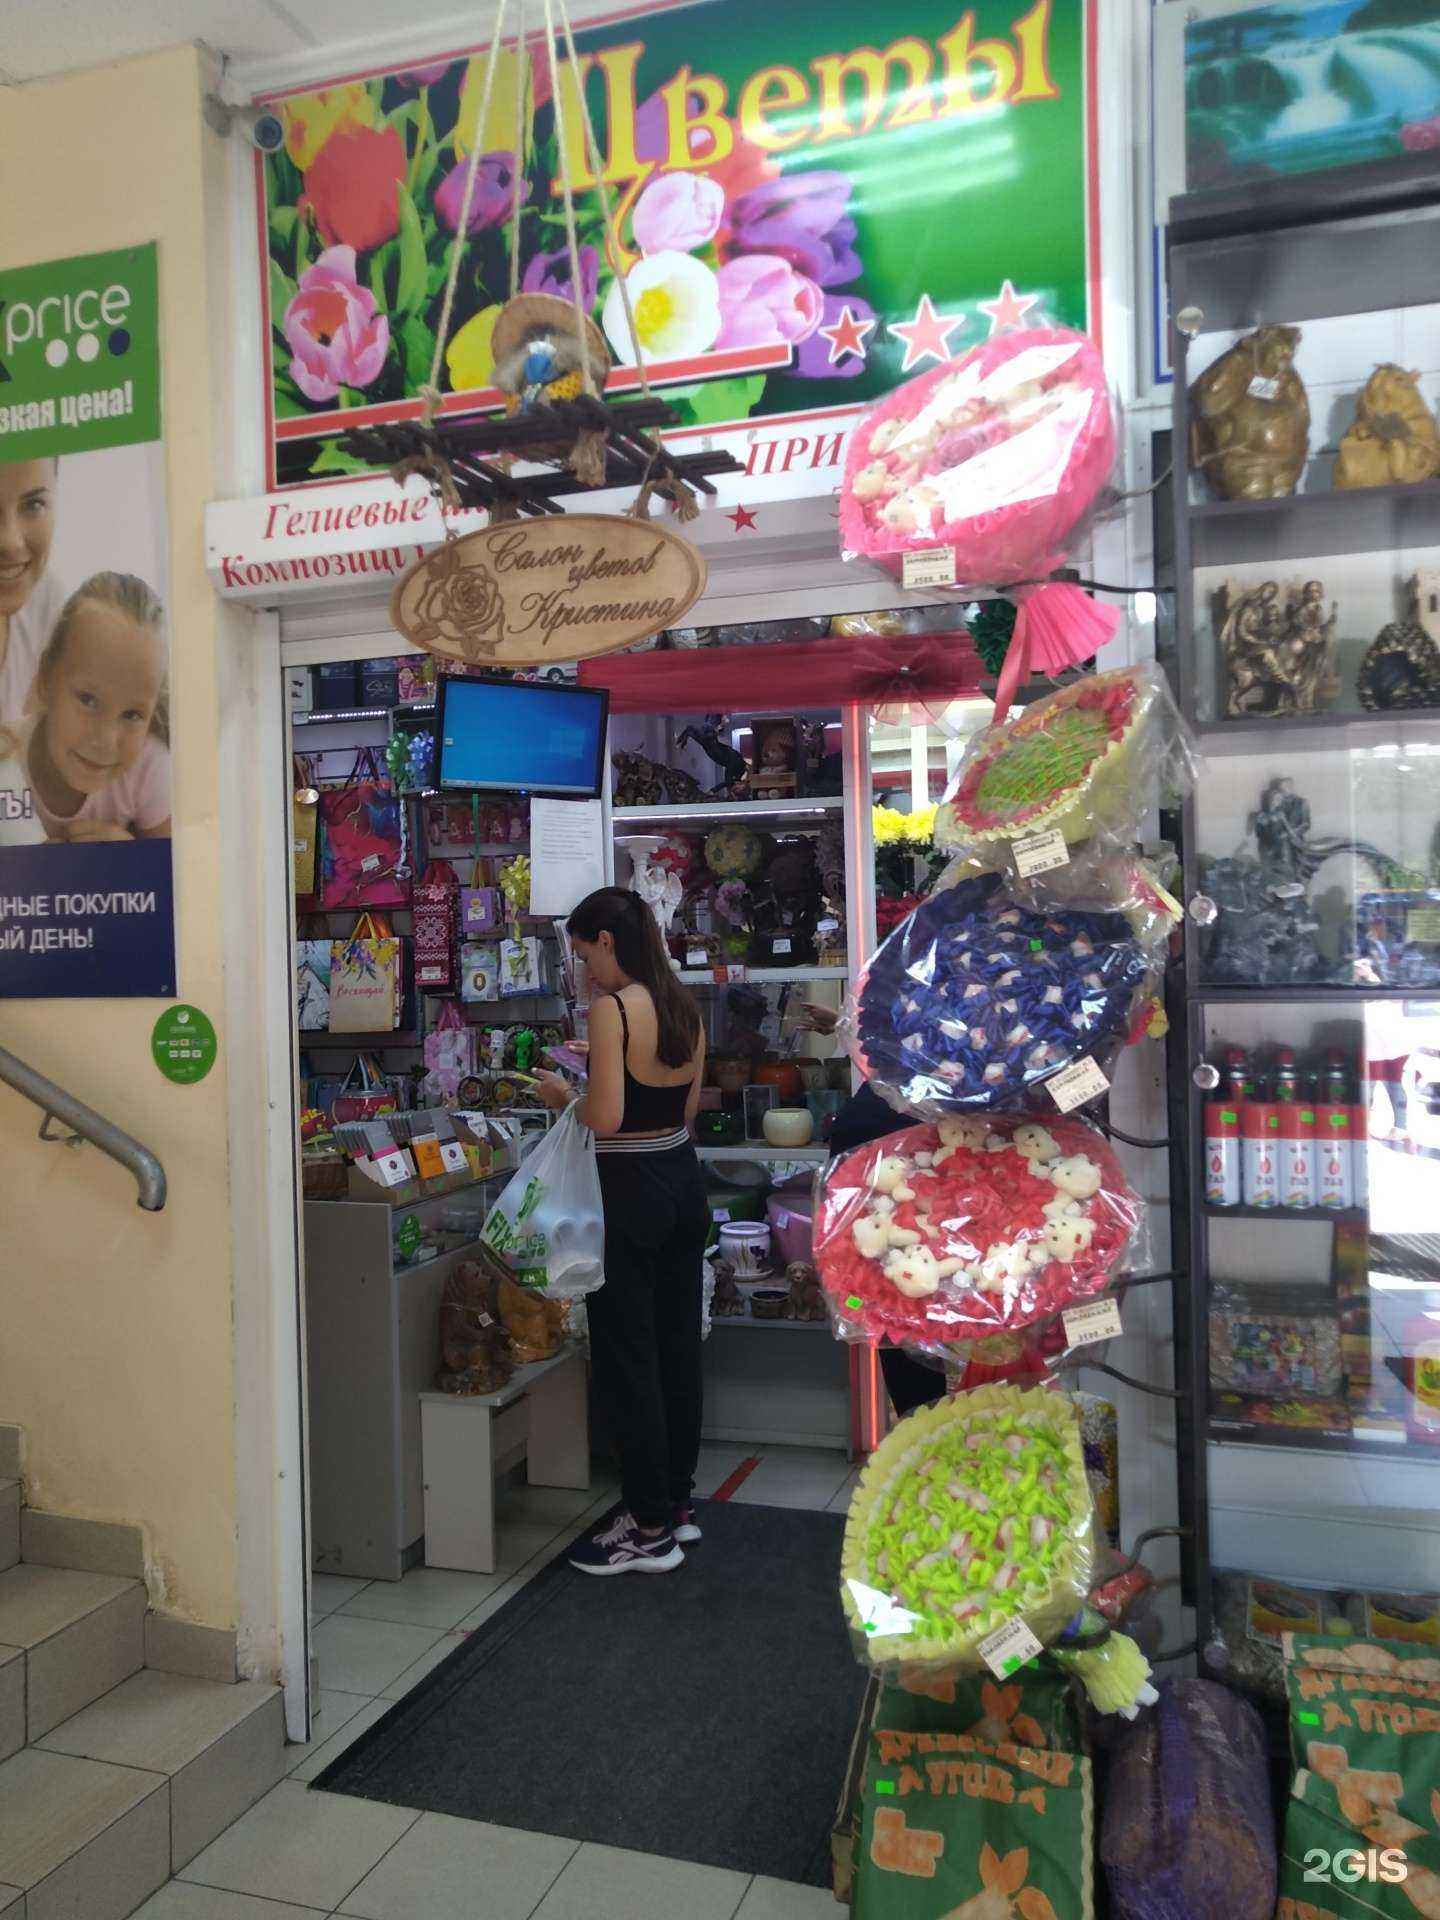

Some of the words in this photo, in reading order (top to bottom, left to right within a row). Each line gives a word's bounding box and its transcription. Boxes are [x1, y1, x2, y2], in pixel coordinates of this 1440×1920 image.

[550, 0, 1057, 275] Цветы
[6, 285, 131, 356] price
[60, 380, 133, 428] цена!
[744, 432, 847, 476] ПРИ
[263, 496, 428, 540] Гелиевые
[486, 531, 584, 573] Салон
[567, 540, 666, 586] цветов
[507, 589, 675, 646] Кристина
[0, 895, 49, 921] НЫЕ
[54, 891, 156, 915] ПОКУПКИ
[29, 927, 93, 954] ДЕНЬ!
